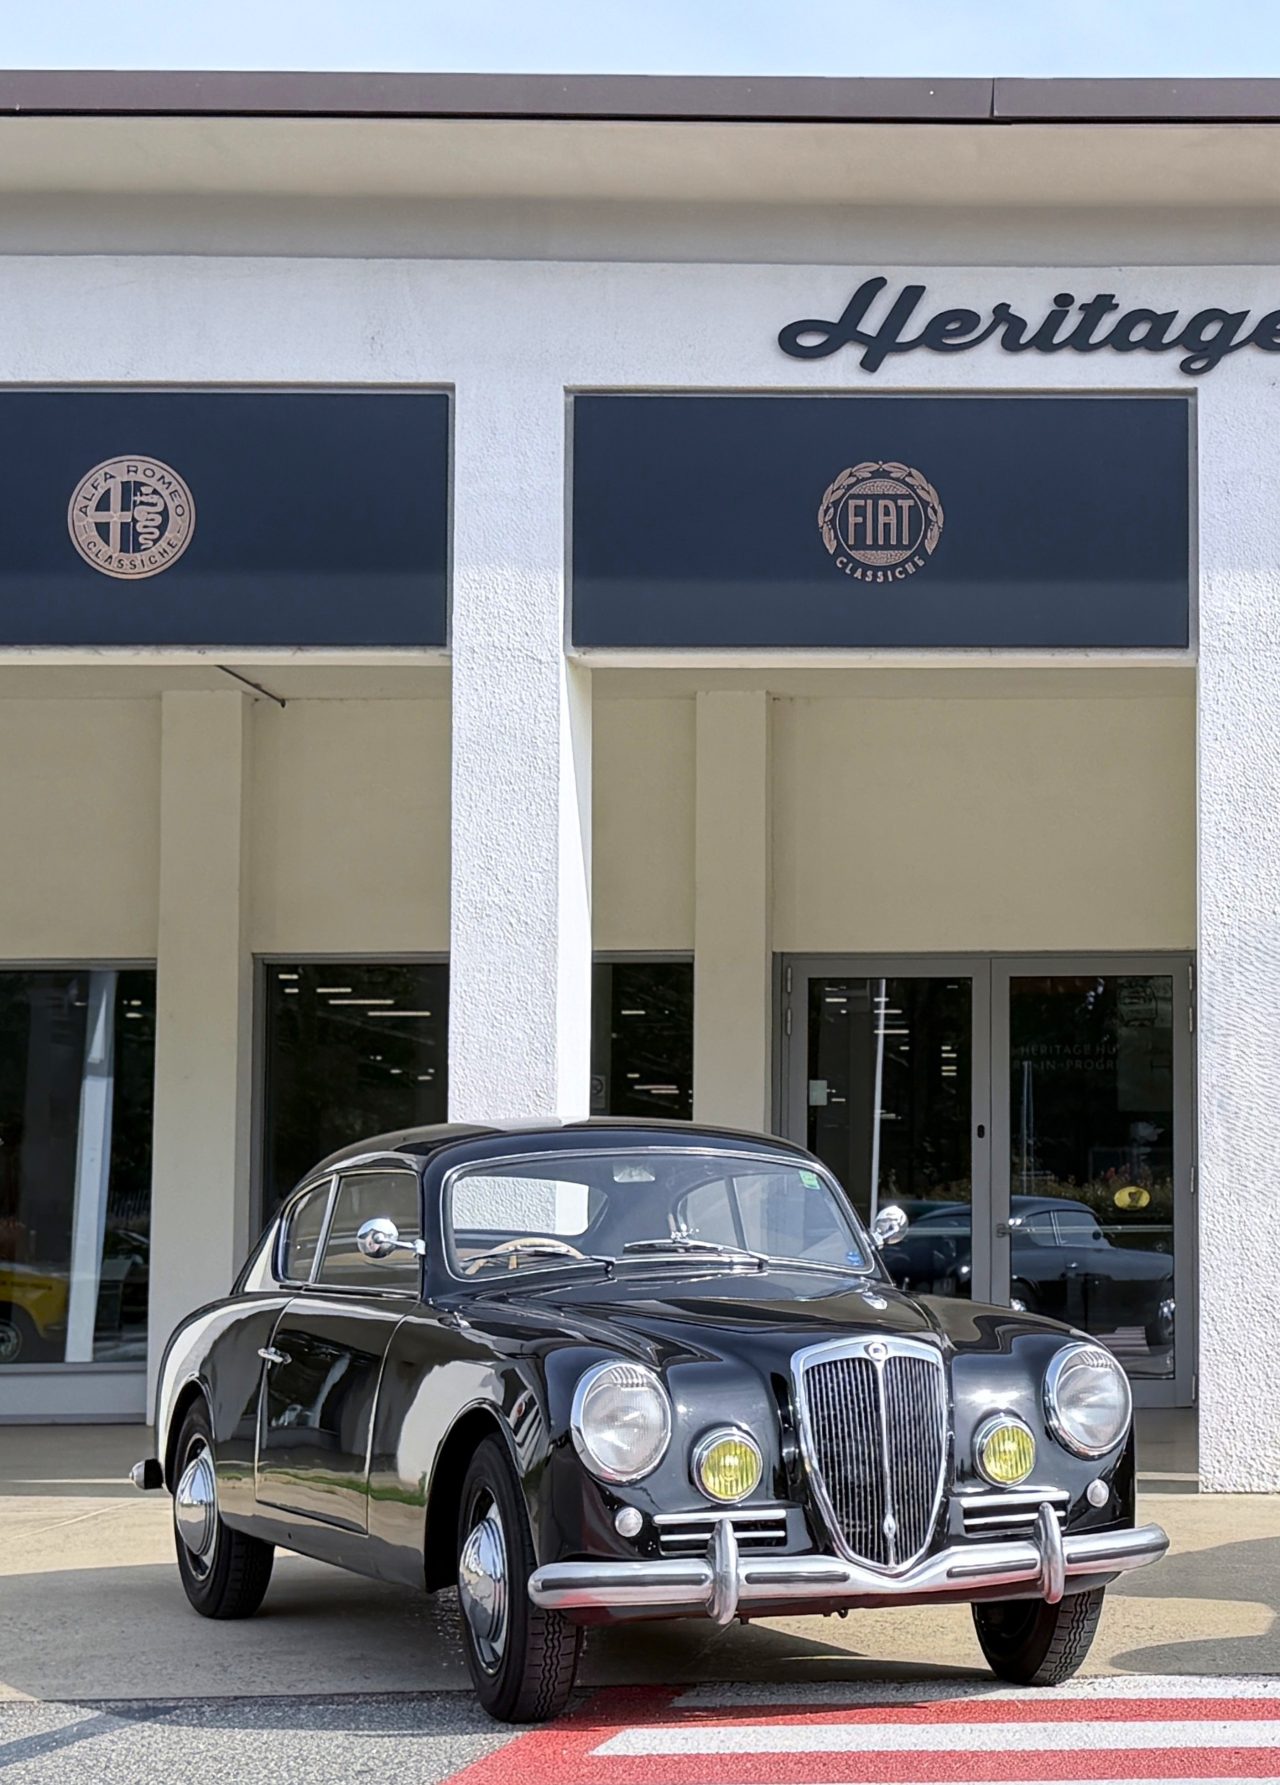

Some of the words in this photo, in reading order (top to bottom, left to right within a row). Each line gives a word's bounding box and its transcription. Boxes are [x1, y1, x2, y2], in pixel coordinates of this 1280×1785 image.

[79, 471, 116, 517] ALFA
[126, 464, 185, 517] ROMEO
[848, 499, 915, 545] FIAT
[87, 538, 178, 570] CLASSICHE
[836, 556, 925, 582] CLASSICHE
